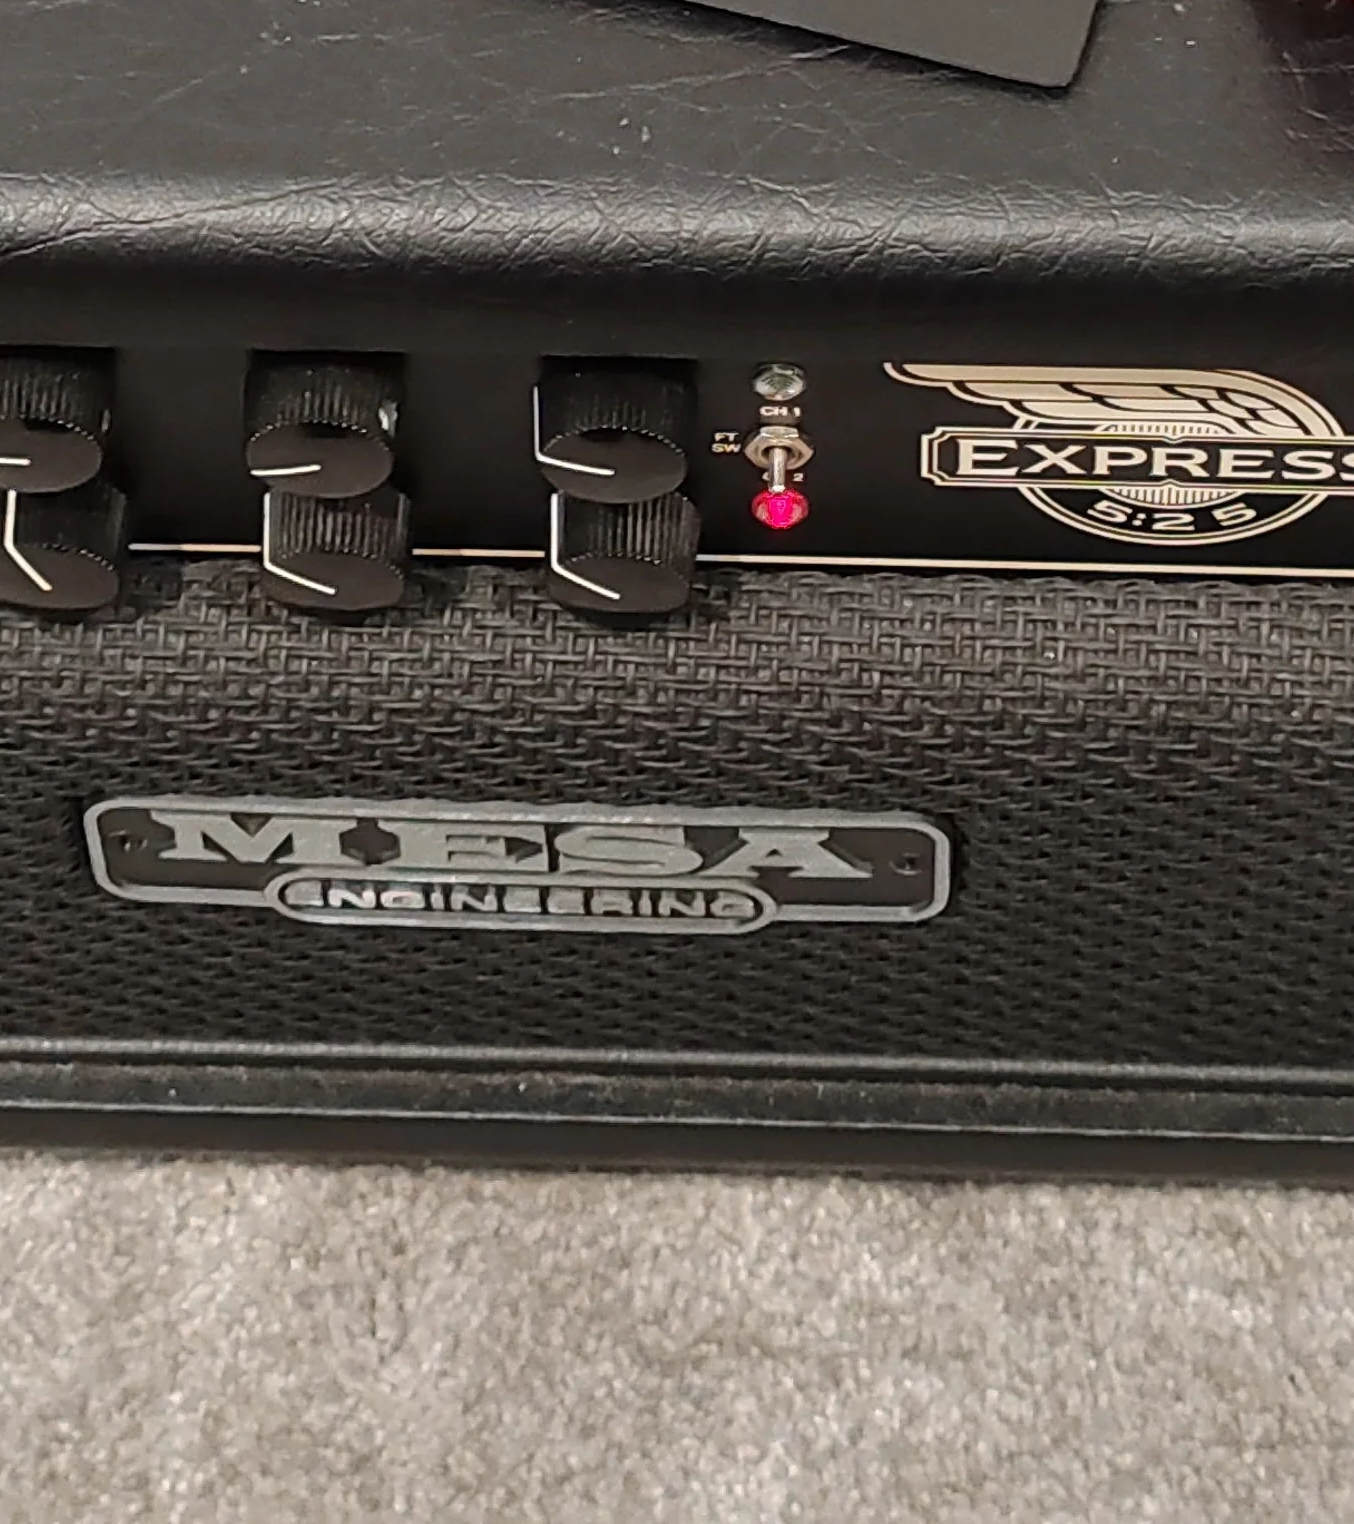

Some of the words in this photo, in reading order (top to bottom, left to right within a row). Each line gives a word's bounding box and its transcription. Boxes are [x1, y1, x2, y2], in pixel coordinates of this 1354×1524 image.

[760, 406, 787, 417] CH
[714, 432, 739, 442] FT
[711, 443, 741, 453] SW
[1087, 498, 1258, 531] 5:25
[150, 809, 874, 878] MESA
[283, 887, 755, 919] ENGINEERING
